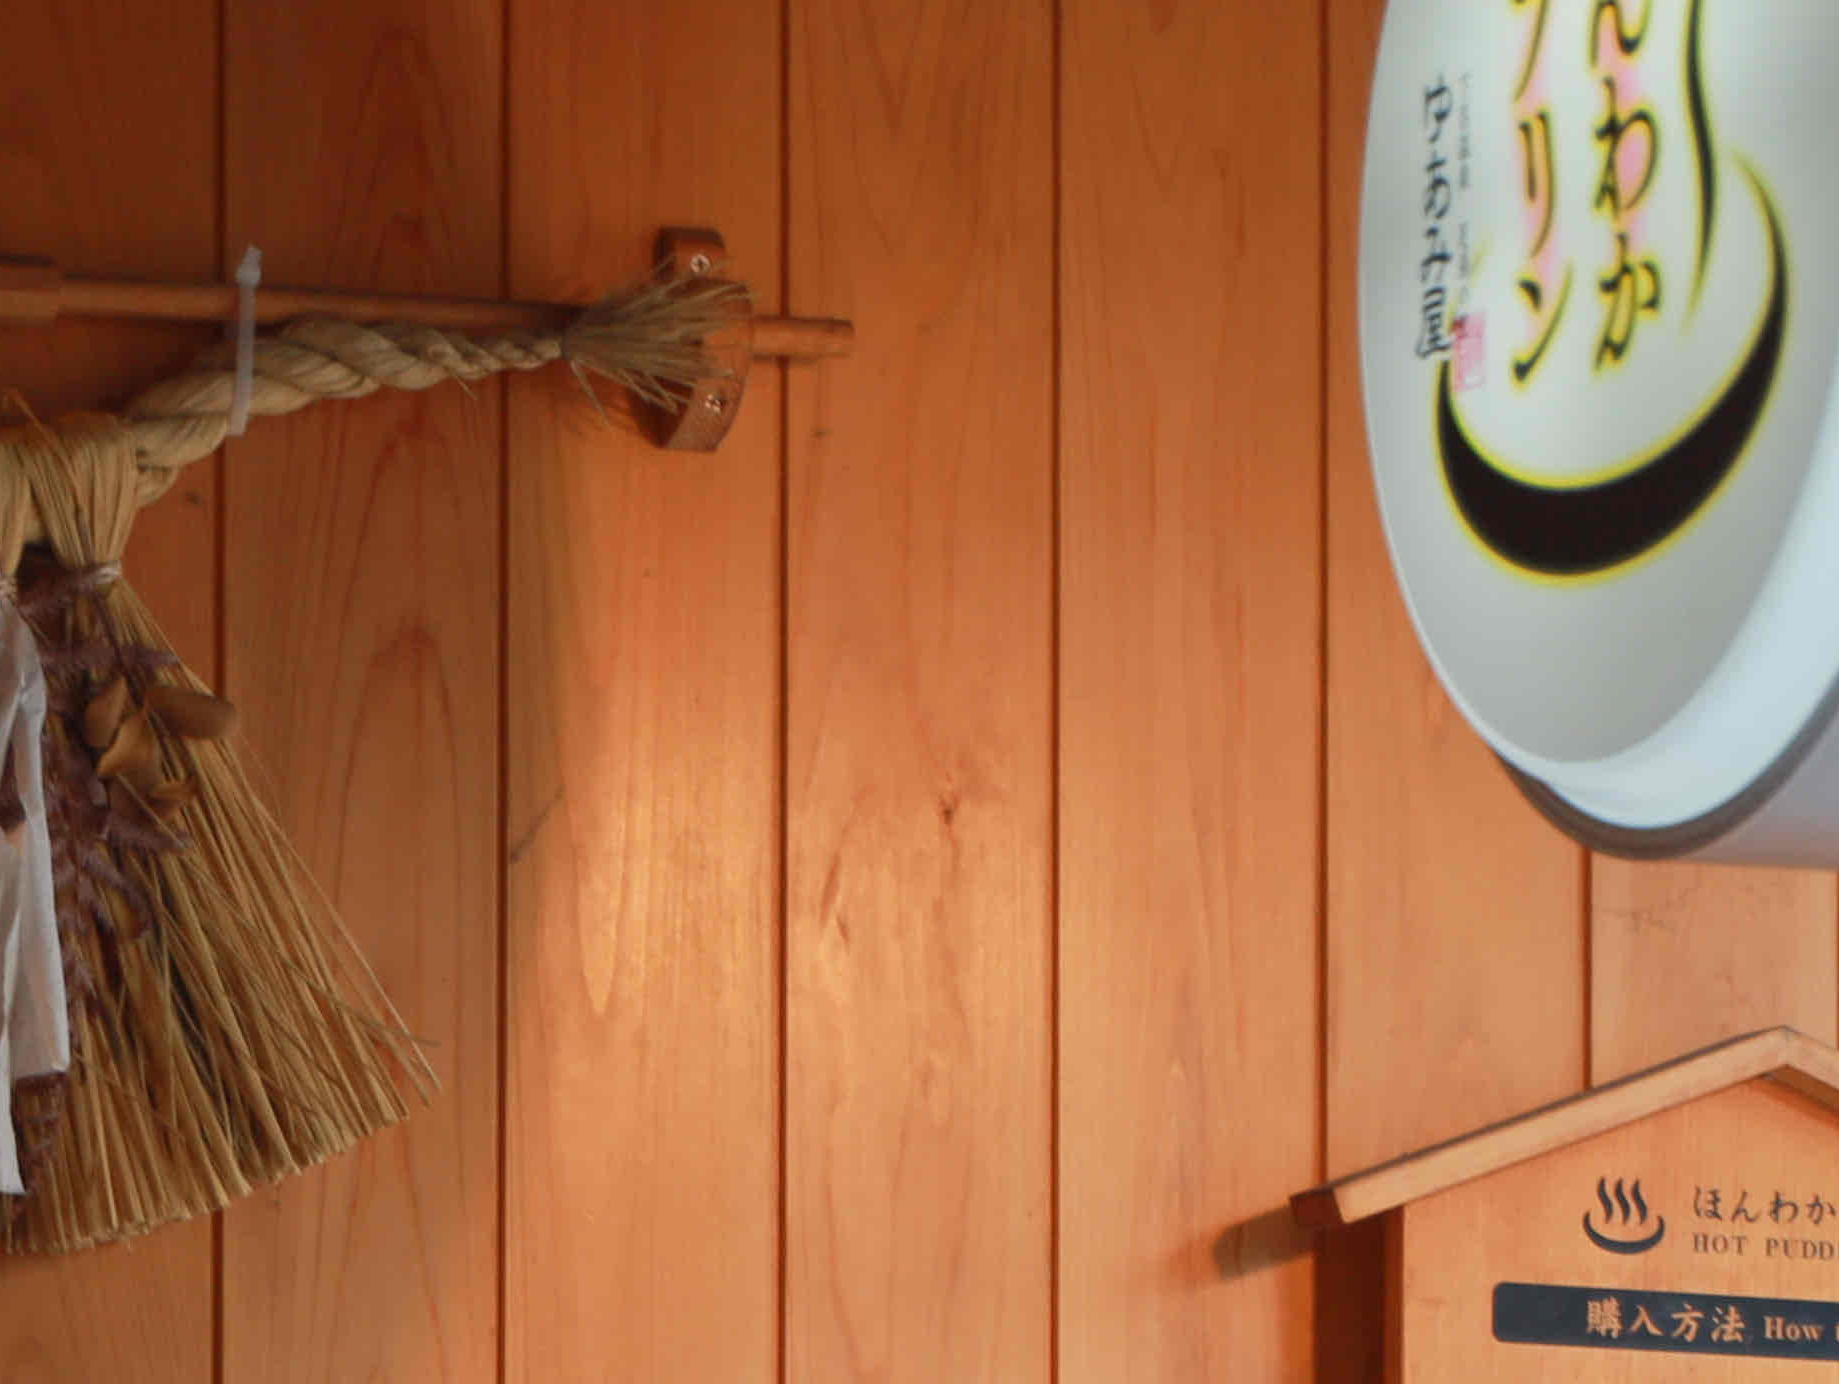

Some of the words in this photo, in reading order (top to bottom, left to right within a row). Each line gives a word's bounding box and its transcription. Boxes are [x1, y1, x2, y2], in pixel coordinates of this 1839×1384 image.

[1693, 1232, 1747, 1256] HOT
[1586, 1296, 1746, 1343] 購入方法
[1764, 1315, 1823, 1342] How
